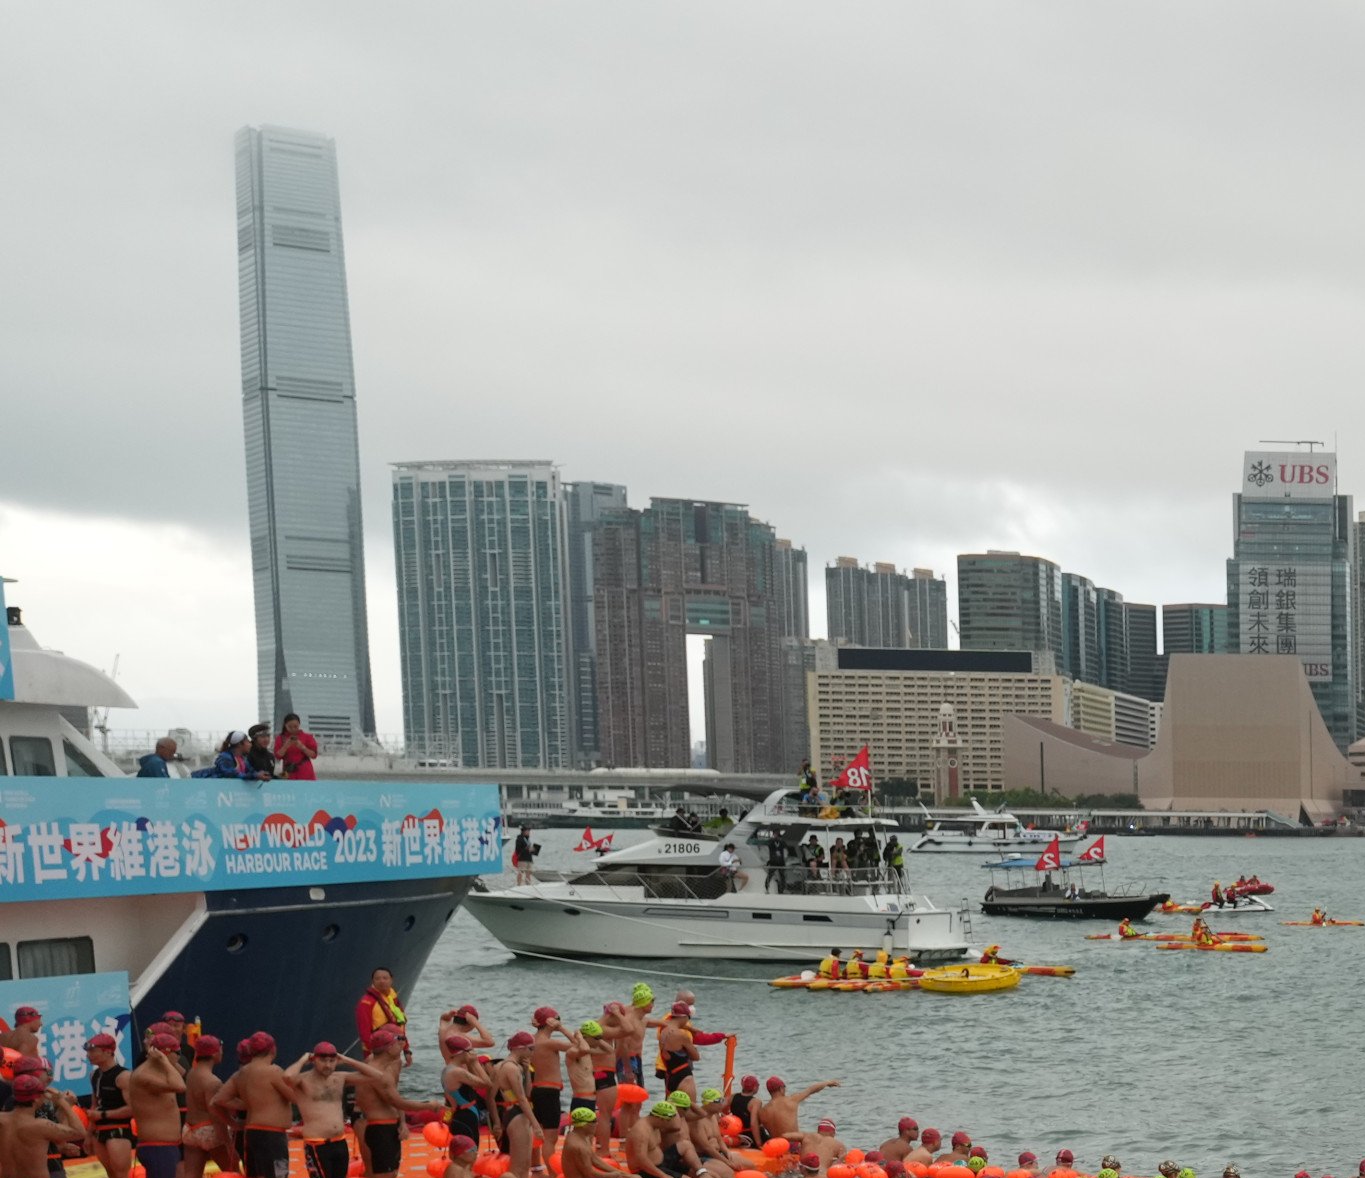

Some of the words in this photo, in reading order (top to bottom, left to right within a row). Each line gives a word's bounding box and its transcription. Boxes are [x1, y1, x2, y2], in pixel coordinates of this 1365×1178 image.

[1279, 464, 1329, 485] UBS
[222, 823, 261, 850] NEW
[265, 822, 326, 848] WORLD
[332, 829, 377, 863] 2023
[381, 817, 499, 867] 新世界維港泳
[664, 843, 700, 854] 21806
[226, 853, 291, 874] HARBOUR
[294, 851, 328, 871] RACE
